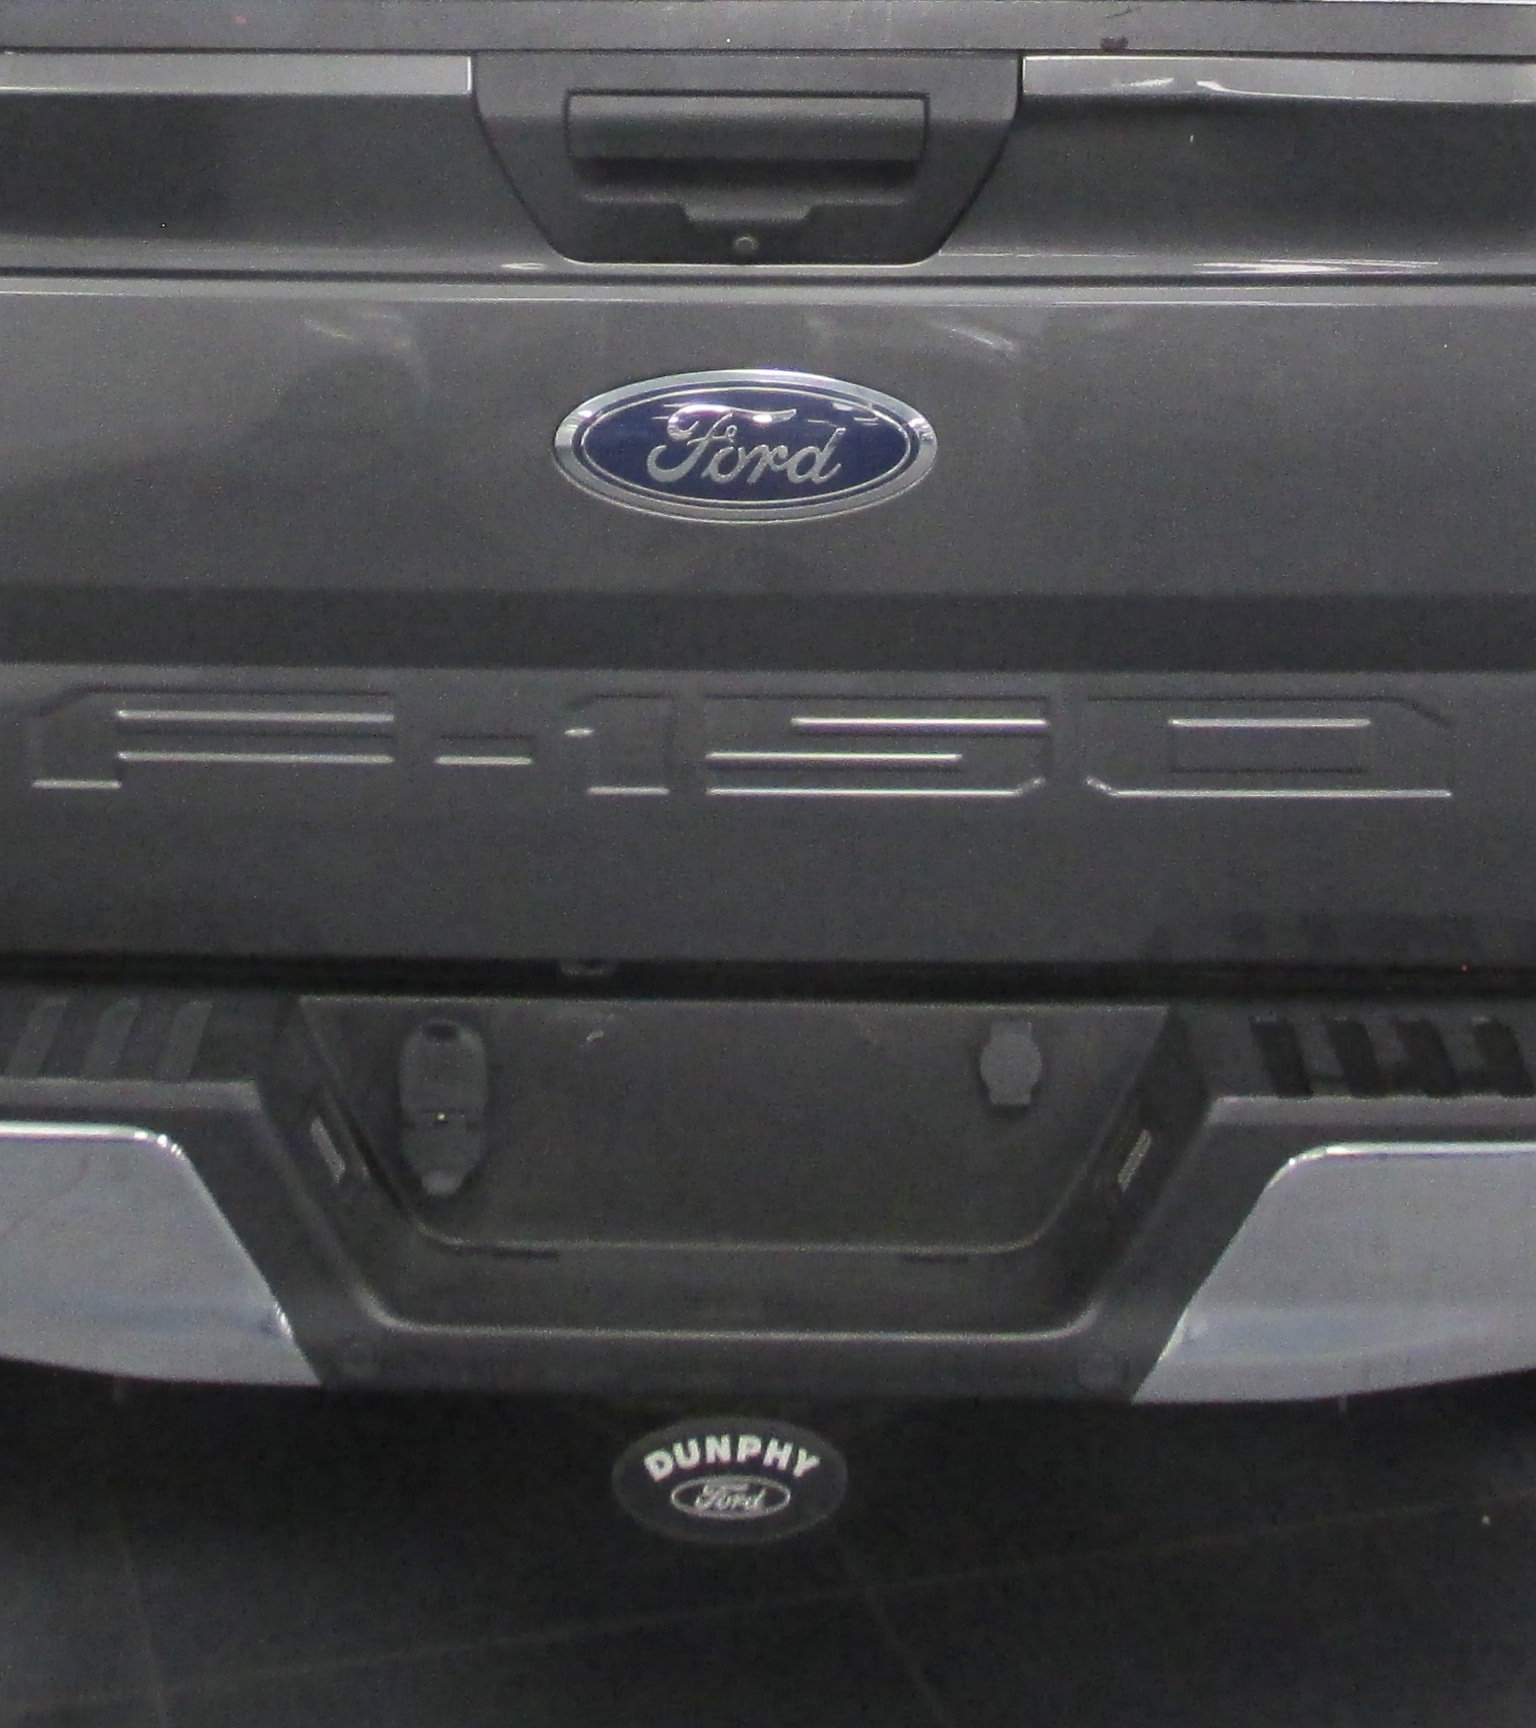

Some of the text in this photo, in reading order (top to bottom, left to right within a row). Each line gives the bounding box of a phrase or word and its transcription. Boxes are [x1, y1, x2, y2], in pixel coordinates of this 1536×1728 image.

[646, 403, 848, 485] Ford
[643, 1434, 821, 1482] DUNPHY
[693, 1481, 767, 1512] Ford
